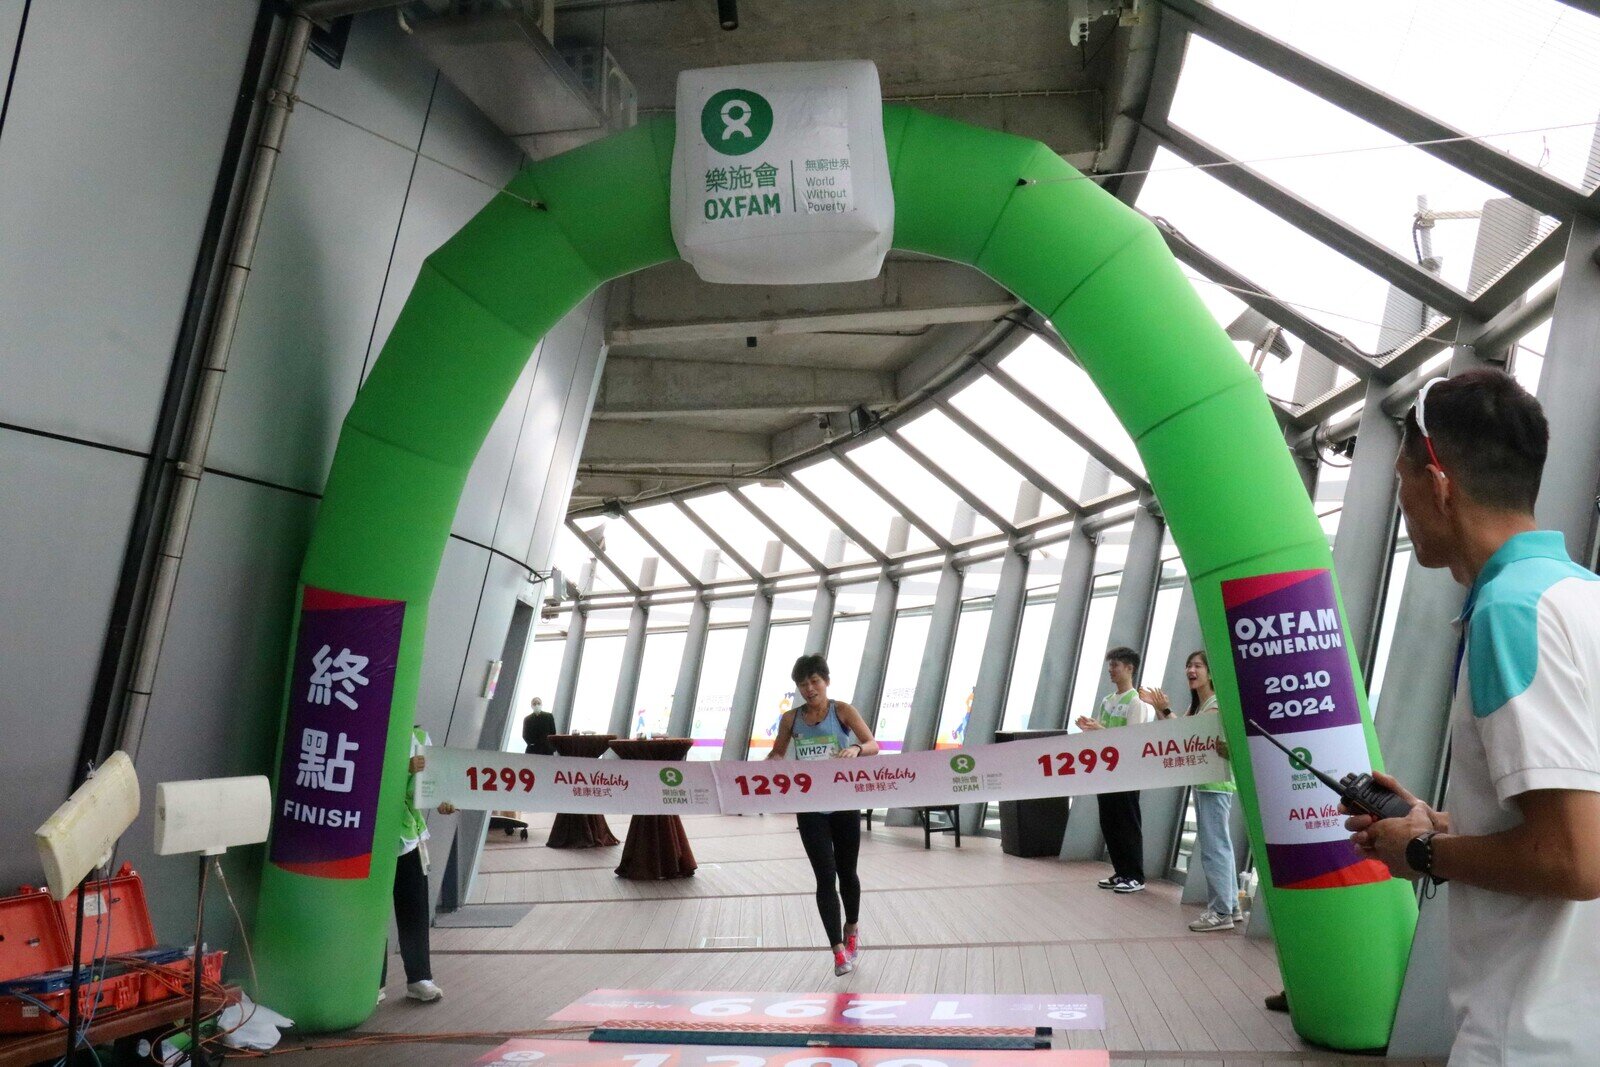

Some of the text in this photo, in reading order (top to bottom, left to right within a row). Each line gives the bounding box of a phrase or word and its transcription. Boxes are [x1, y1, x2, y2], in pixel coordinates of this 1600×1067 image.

[805, 158, 850, 171] 無窮世界
[704, 161, 779, 193] 樂施會
[805, 176, 835, 187] World
[806, 189, 847, 200] Without
[704, 193, 781, 221] OXFAM
[807, 201, 846, 213] Poverty
[1234, 608, 1339, 641] OXFAM
[1237, 633, 1342, 659] TOWERRUN
[1264, 670, 1331, 694] 20.10
[1268, 695, 1336, 719] 2024
[295, 644, 370, 793] 終點
[799, 745, 827, 756] WH27
[1142, 733, 1220, 758] AIA Vitali
[1037, 746, 1120, 777] 1299
[1162, 753, 1208, 769] 健康程式
[465, 766, 536, 793] 1299
[554, 770, 629, 791] AIA Vitality
[735, 773, 812, 796] 1299
[833, 766, 916, 784] AIA Vitality
[572, 786, 613, 798] 健康程式
[855, 782, 898, 793] 健康程式
[952, 783, 980, 793] OXFAM
[1292, 782, 1317, 791] OXFAM
[662, 797, 688, 805] OXFAM
[1289, 803, 1341, 820] AIA Vita
[283, 799, 361, 828] FINISH
[690, 998, 973, 1020] 1299
